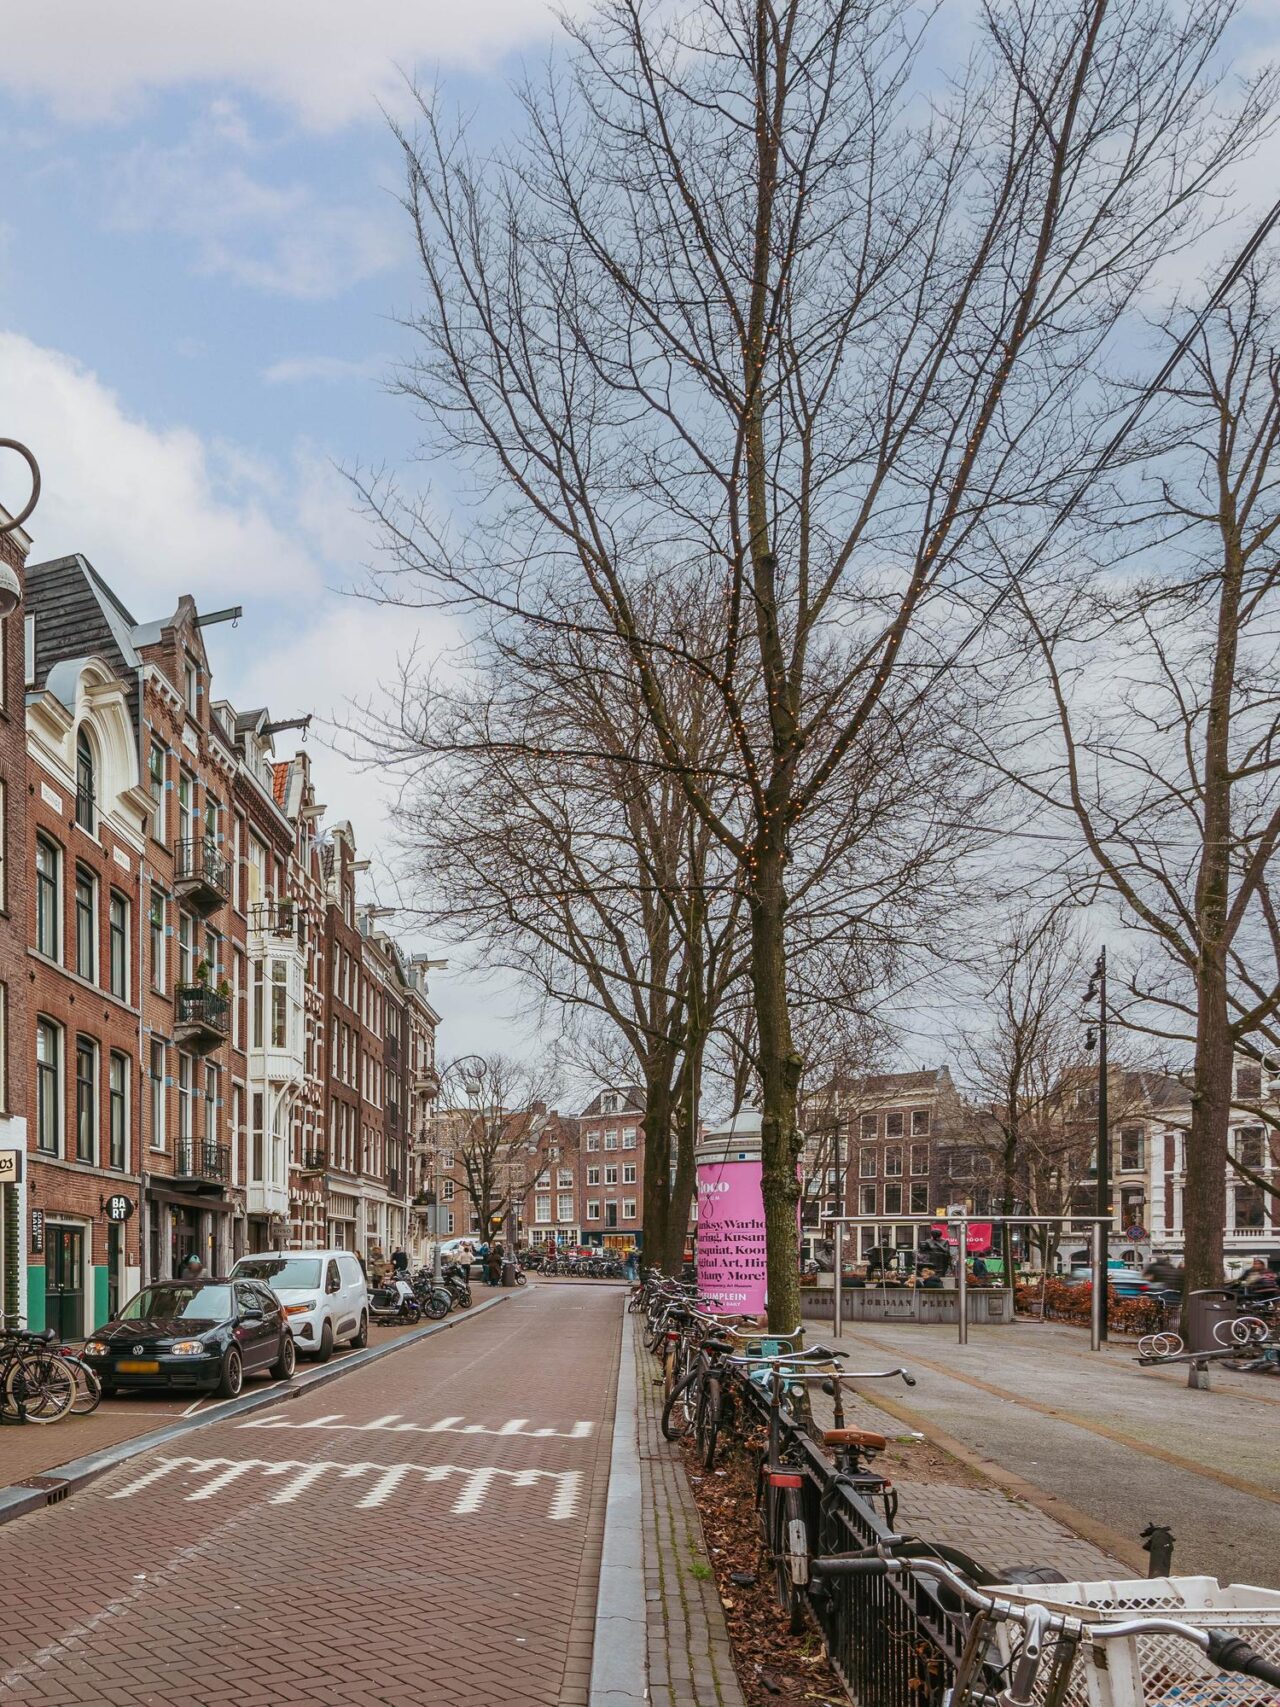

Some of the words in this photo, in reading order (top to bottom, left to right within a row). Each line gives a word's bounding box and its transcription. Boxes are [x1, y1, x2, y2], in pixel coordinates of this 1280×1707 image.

[112, 1197, 126, 1208] BA
[112, 1208, 126, 1219] RT
[727, 1271, 766, 1281] More!
[808, 1298, 850, 1306] JOHNY
[860, 1299, 912, 1307] JORDAAN
